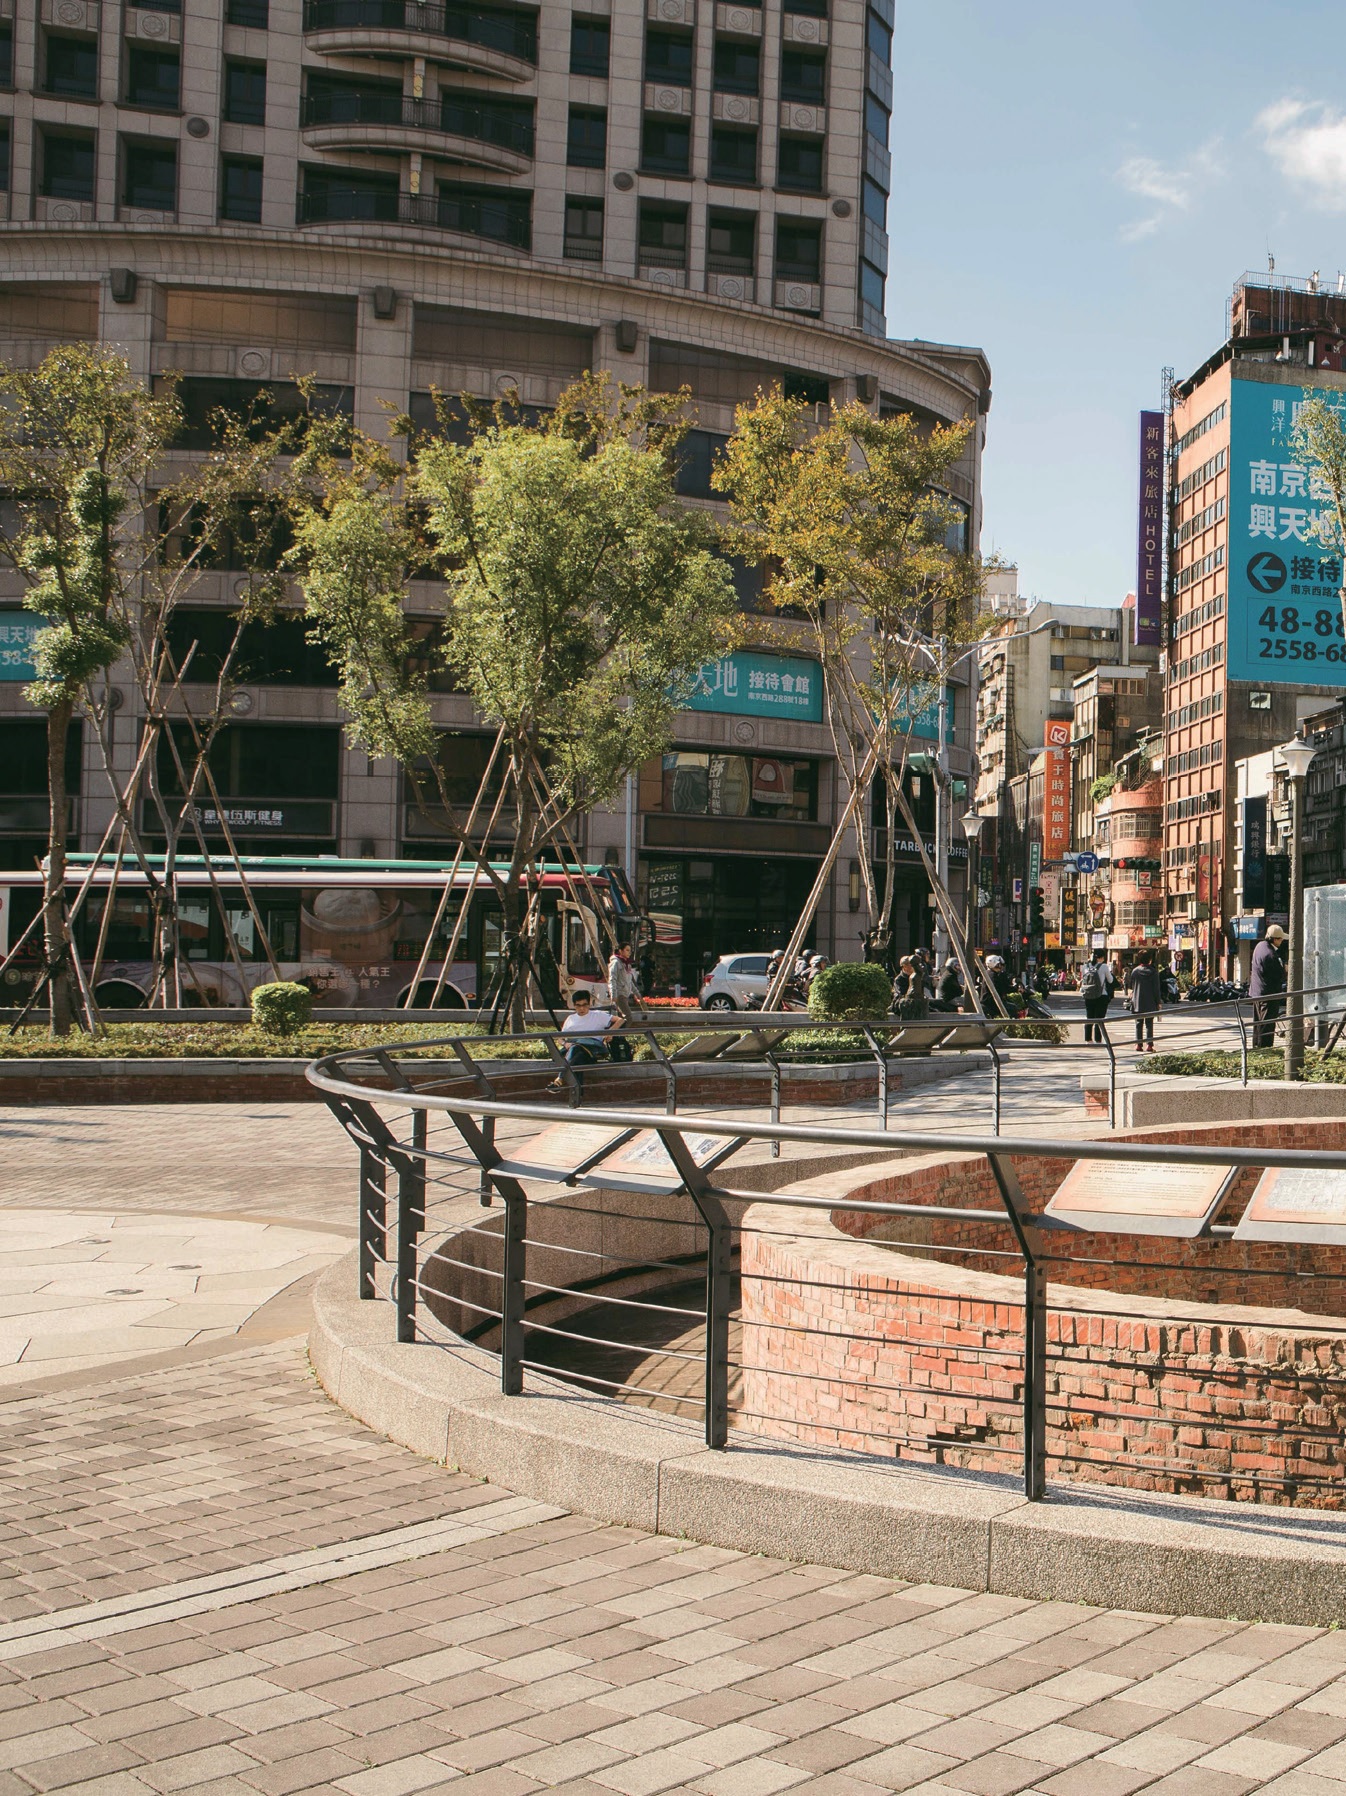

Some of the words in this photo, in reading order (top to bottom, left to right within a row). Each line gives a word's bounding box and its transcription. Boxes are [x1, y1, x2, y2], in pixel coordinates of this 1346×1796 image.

[1145, 427, 1159, 519] 新客來旅店
[1145, 525, 1156, 595] HOTEL
[749, 670, 810, 694] 接待會館
[358, 966, 390, 977] 人氣王
